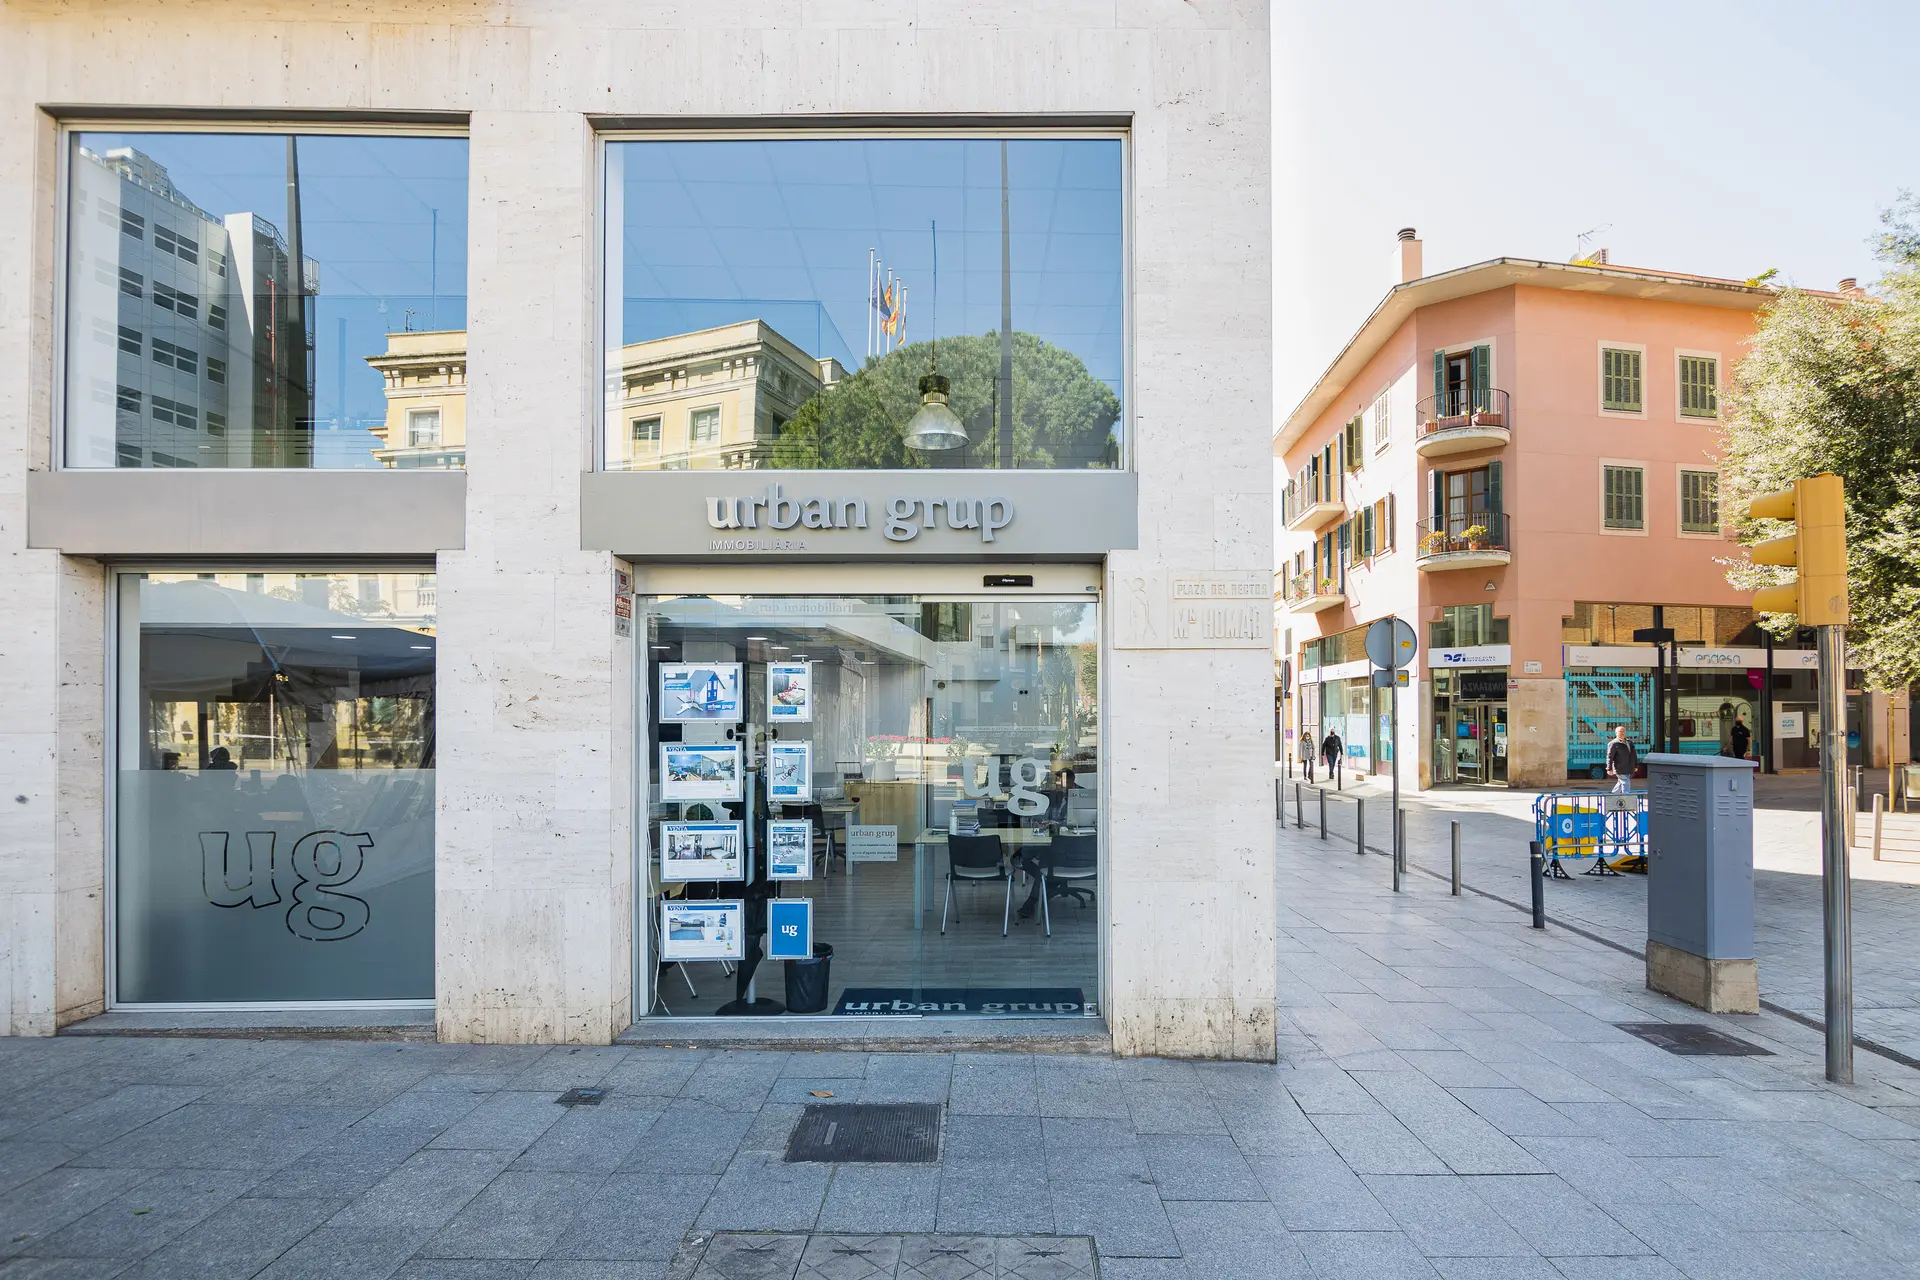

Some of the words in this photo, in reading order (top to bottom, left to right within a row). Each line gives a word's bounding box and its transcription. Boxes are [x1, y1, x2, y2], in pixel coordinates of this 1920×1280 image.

[705, 482, 868, 530] urban
[883, 495, 1015, 543] grup
[1176, 584, 1207, 596] PLAZA
[1210, 584, 1229, 596] DEL
[1231, 584, 1268, 596] RECTOR
[1695, 653, 1741, 665] endesa
[963, 757, 1051, 816] ug
[850, 829, 874, 837] urban
[876, 830, 896, 839] grup
[199, 830, 374, 941] ug
[781, 924, 799, 937] ug
[845, 999, 967, 1012] urban
[979, 1002, 1080, 1015] grup
